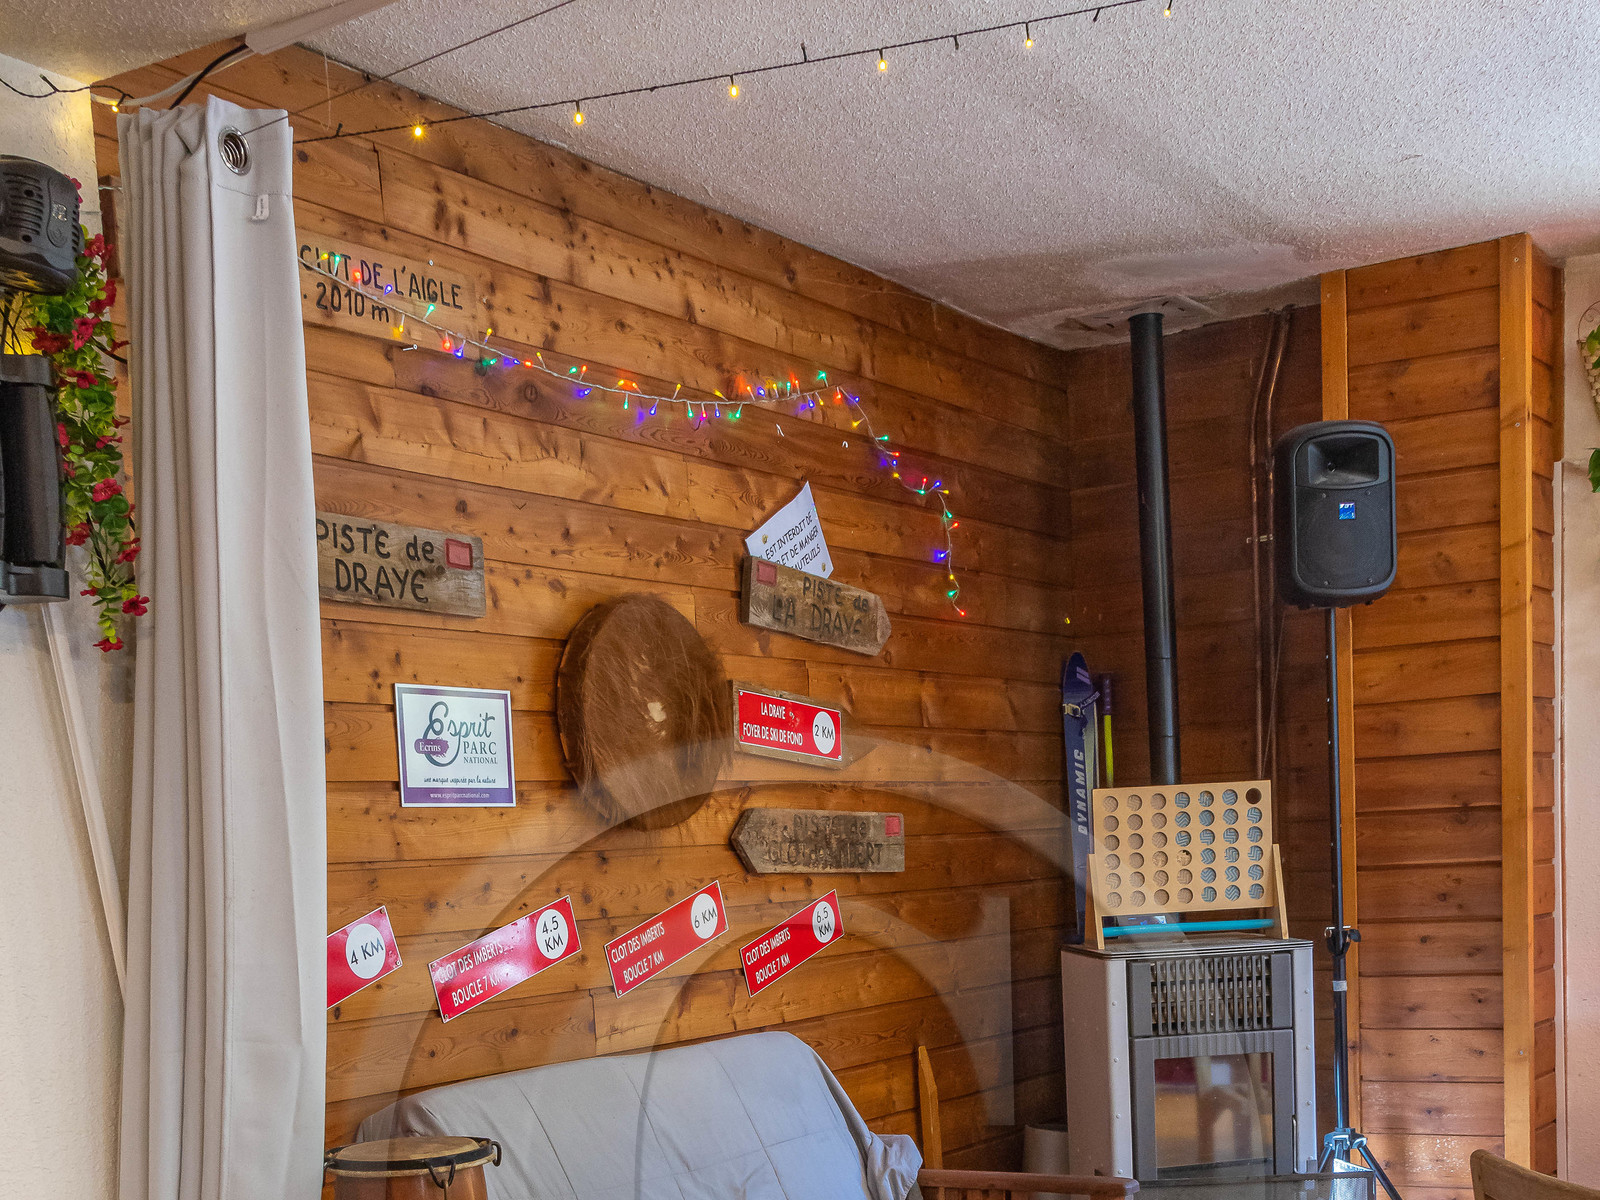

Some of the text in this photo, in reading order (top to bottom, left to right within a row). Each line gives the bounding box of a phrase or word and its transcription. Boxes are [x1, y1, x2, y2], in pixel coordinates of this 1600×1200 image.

[360, 259, 384, 290] DE
[394, 265, 463, 310] L'AIGLE
[316, 282, 389, 323] 2010 m
[406, 535, 434, 563] de
[765, 511, 813, 560] EST INTERDIT DE
[790, 544, 799, 558] DE
[799, 525, 819, 550] MANGER
[791, 544, 821, 571] AUTEUILS
[335, 558, 429, 603] DRAYE
[773, 594, 796, 628] LA
[761, 702, 786, 720] LA DRAYE
[422, 701, 496, 767] Esprit
[463, 741, 497, 755] PARC
[743, 722, 803, 746] FOYER DE SKI DE FOND
[814, 724, 835, 740] 2 KM
[1073, 749, 1089, 836] DYNAMIC
[542, 915, 559, 934] 4.5
[694, 907, 718, 929] 6 KM
[816, 906, 829, 923] 6.5
[818, 922, 832, 937] KM
[350, 937, 384, 966] 4 KM
[545, 933, 564, 952] KM
[611, 921, 665, 964] CLOT DES IMBERTS
[745, 927, 791, 966] CLOT DES IMBERTS
[437, 941, 504, 984] CLOT DES IMBERTS
[623, 949, 665, 984] BOUCLE 7 KM
[755, 952, 791, 984] BOUCLE 7 KM
[451, 978, 484, 1007] BOUCLE
[482, 975, 488, 991] 7
